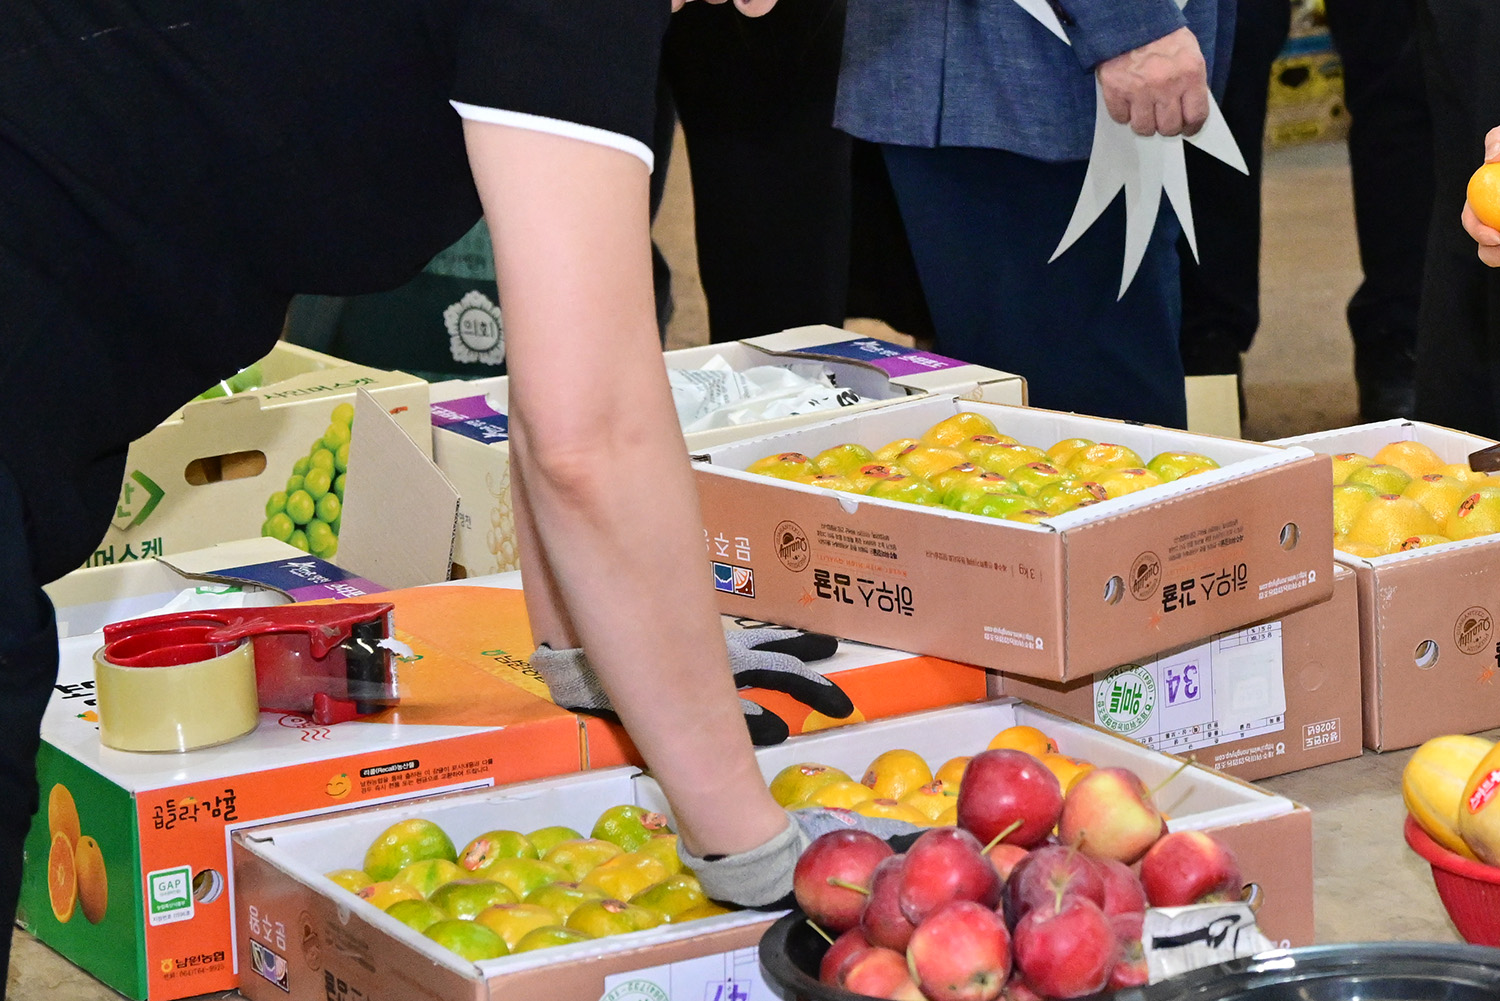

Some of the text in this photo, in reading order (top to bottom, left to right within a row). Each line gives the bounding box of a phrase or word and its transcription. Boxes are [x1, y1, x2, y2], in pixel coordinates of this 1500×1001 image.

[779, 536, 807, 558] Quality
[1132, 561, 1160, 593] Quality
[1161, 563, 1248, 613] 하우스 감귤
[813, 569, 915, 617] 하우스 감귤
[1458, 617, 1491, 648] Quality
[1165, 664, 1199, 704] 34
[1305, 731, 1339, 746] 생산연도
[1306, 720, 1337, 736] 2026년
[152, 788, 239, 830] 곱들락 감귤
[158, 879, 182, 892] GAP
[175, 951, 226, 969] 남원농협
